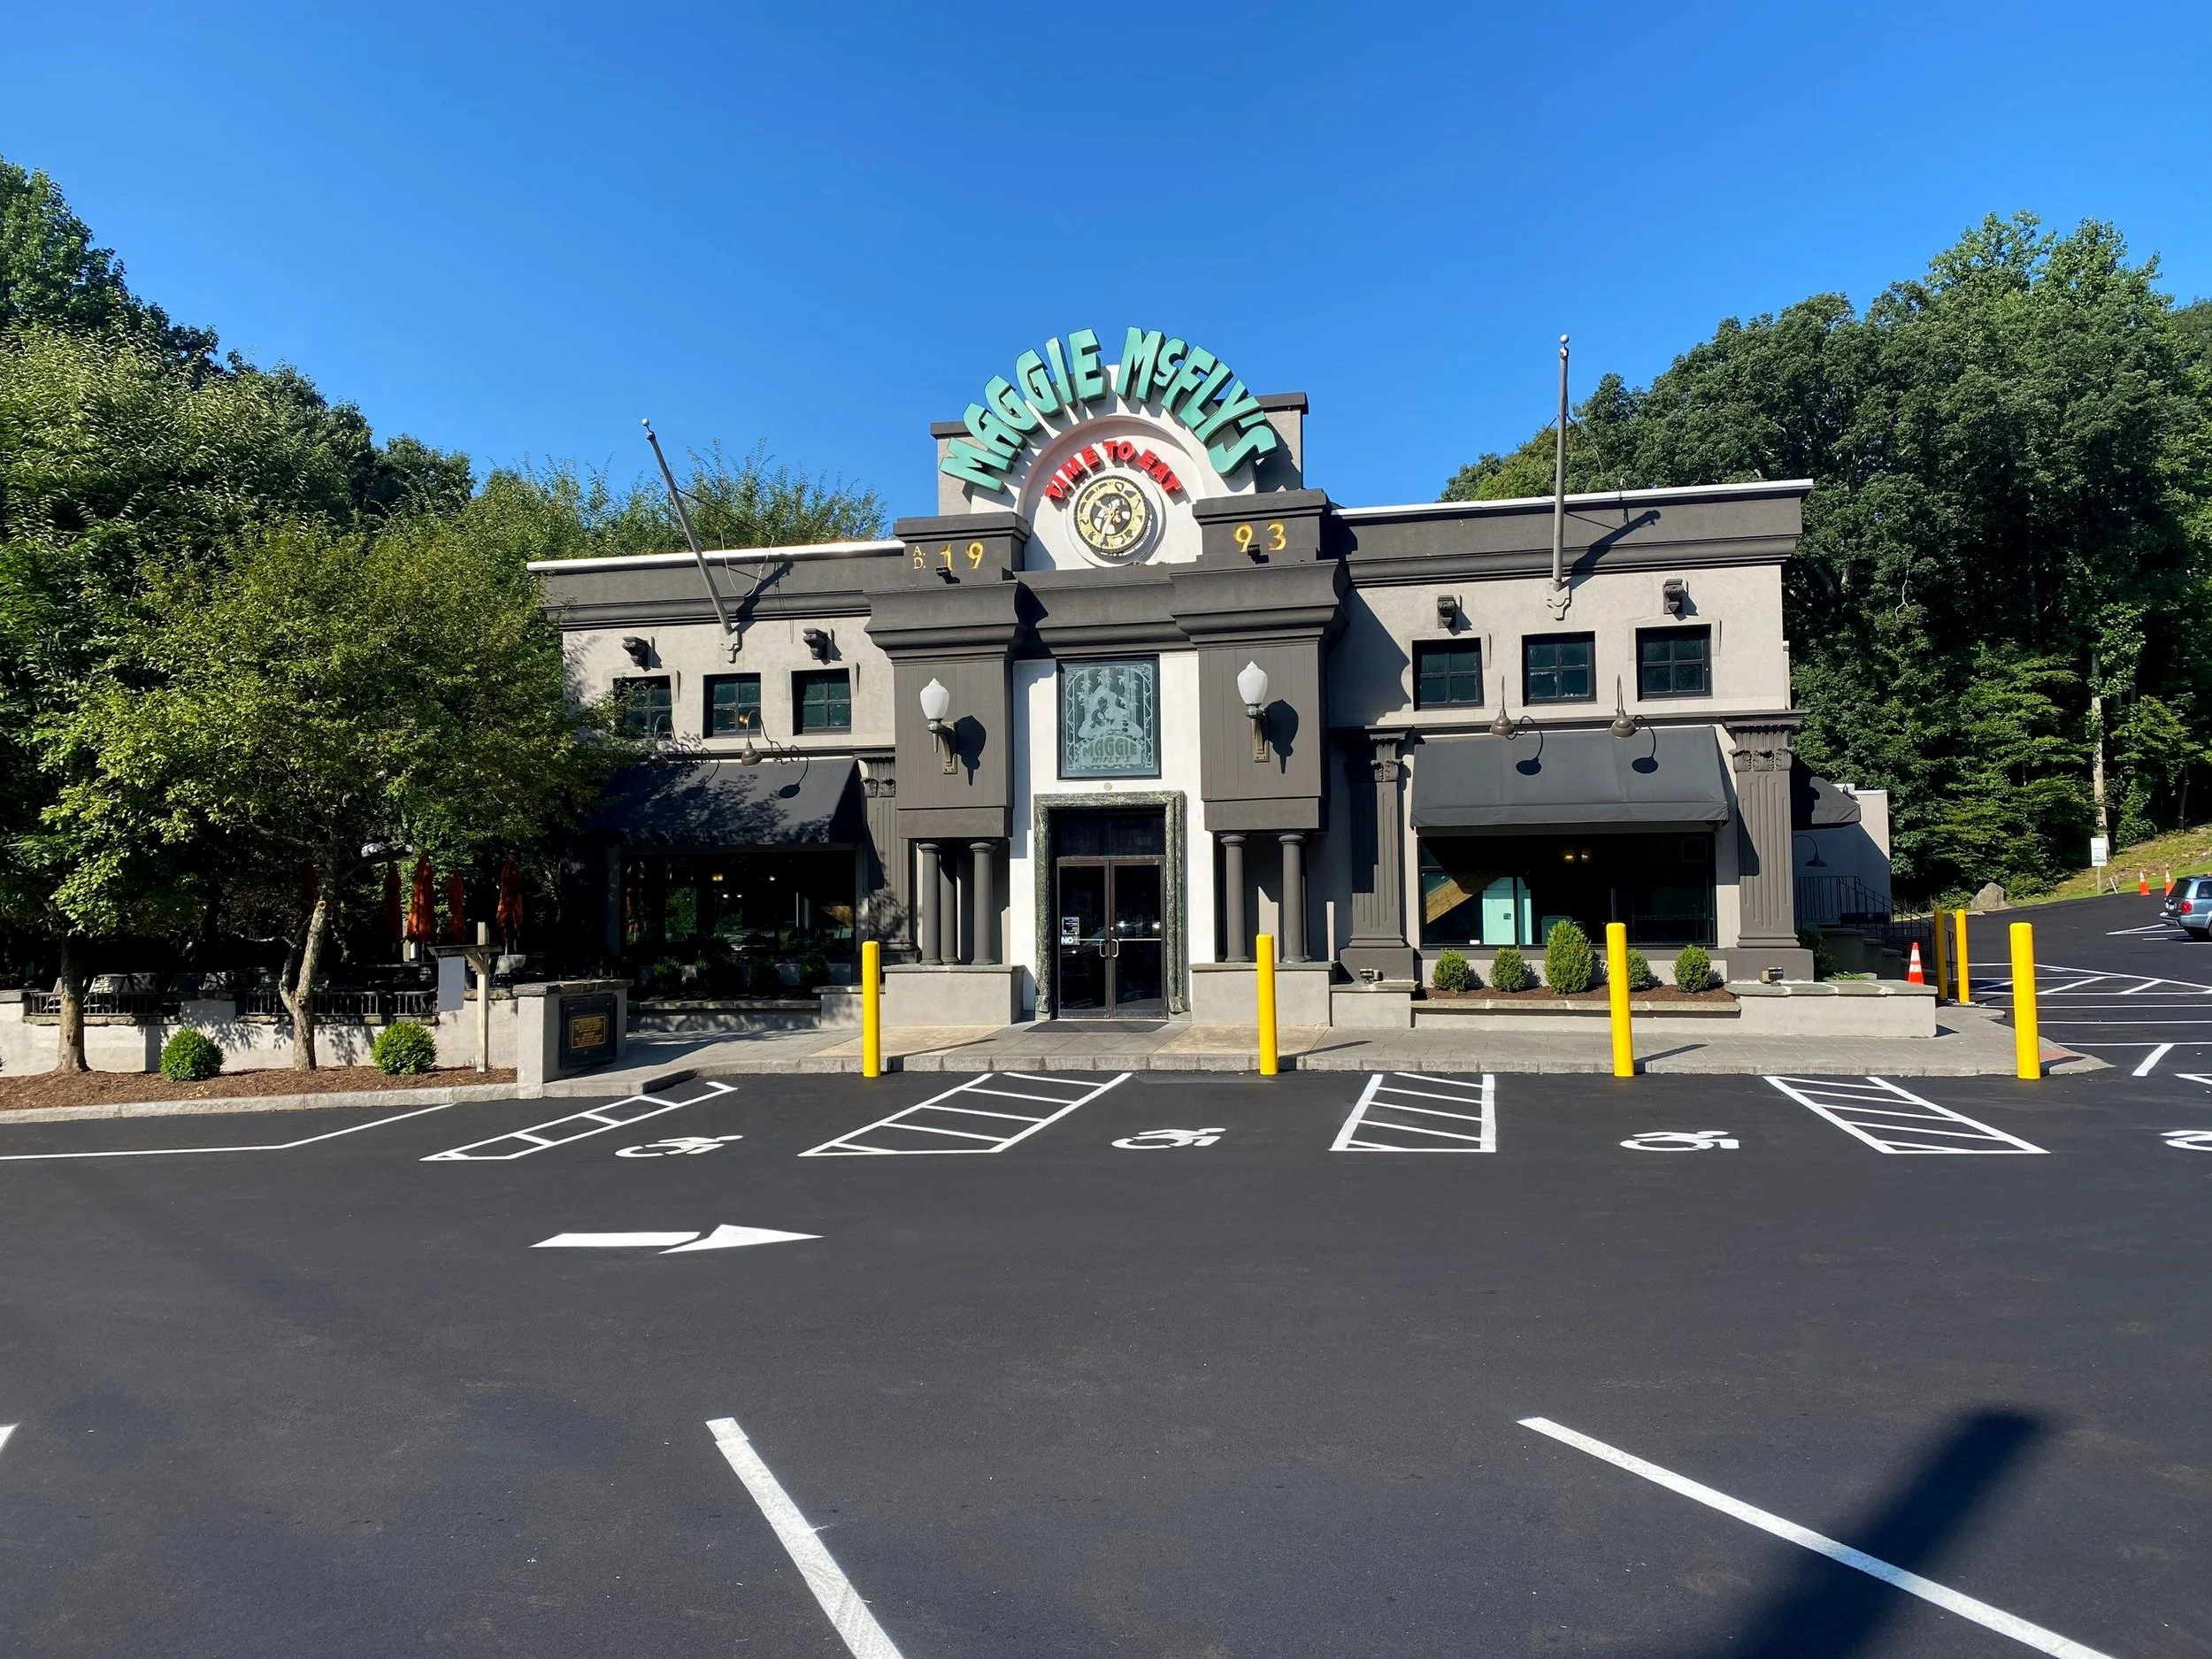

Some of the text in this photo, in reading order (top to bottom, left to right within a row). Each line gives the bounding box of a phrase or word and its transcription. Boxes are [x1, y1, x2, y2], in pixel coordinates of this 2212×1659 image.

[939, 328, 1108, 495] MAGGIE
[1044, 440, 1183, 502] TIME TO EAT
[1233, 521, 1286, 553] 93
[1082, 736, 1138, 757] MAGGIE
